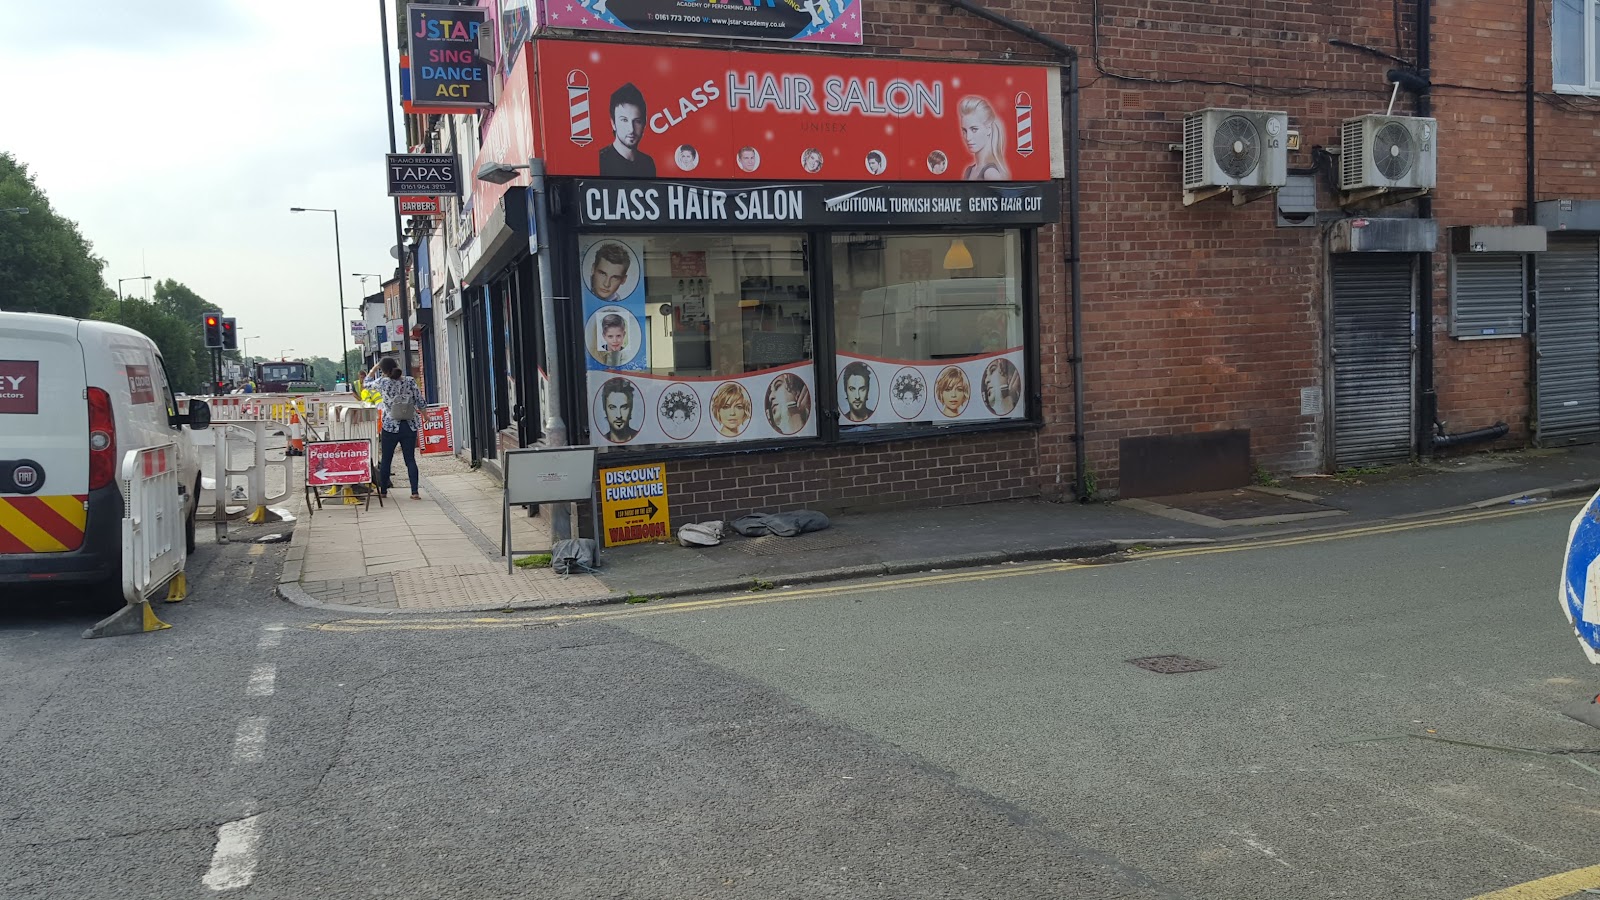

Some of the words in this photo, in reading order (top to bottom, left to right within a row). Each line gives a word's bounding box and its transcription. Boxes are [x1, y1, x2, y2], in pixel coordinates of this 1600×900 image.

[711, 3, 744, 11] PERFORMING
[654, 13, 669, 21] 0161
[670, 14, 682, 22] 773
[683, 15, 701, 23] 7000
[711, 18, 786, 28] www.jstar-academy.co.uk
[429, 49, 472, 63] SING
[421, 66, 482, 81] DANCE
[435, 84, 470, 98] ACT
[649, 79, 720, 135] CLASS
[729, 74, 816, 111] HAIR
[826, 79, 941, 115] SALON
[801, 122, 847, 134] UNISEX
[1267, 138, 1279, 149] LG
[391, 166, 452, 181] TAPAS
[401, 201, 437, 211] BARBERS
[585, 188, 660, 221] CLASS
[667, 185, 728, 220] HAIR
[734, 189, 803, 220] SALON
[889, 197, 931, 213] TURKISH
[932, 197, 962, 213] SHAVE
[968, 197, 998, 212] GENTS
[1000, 197, 1022, 212] HAIR
[1024, 196, 1042, 212] CUT
[423, 420, 444, 430] OPEN
[310, 449, 368, 459] Pedestrians
[18, 472, 33, 482] FIAT
[605, 466, 661, 486] DISCOUNT
[606, 482, 664, 502] FURNITURE
[608, 521, 666, 543] WAREHOUSE
